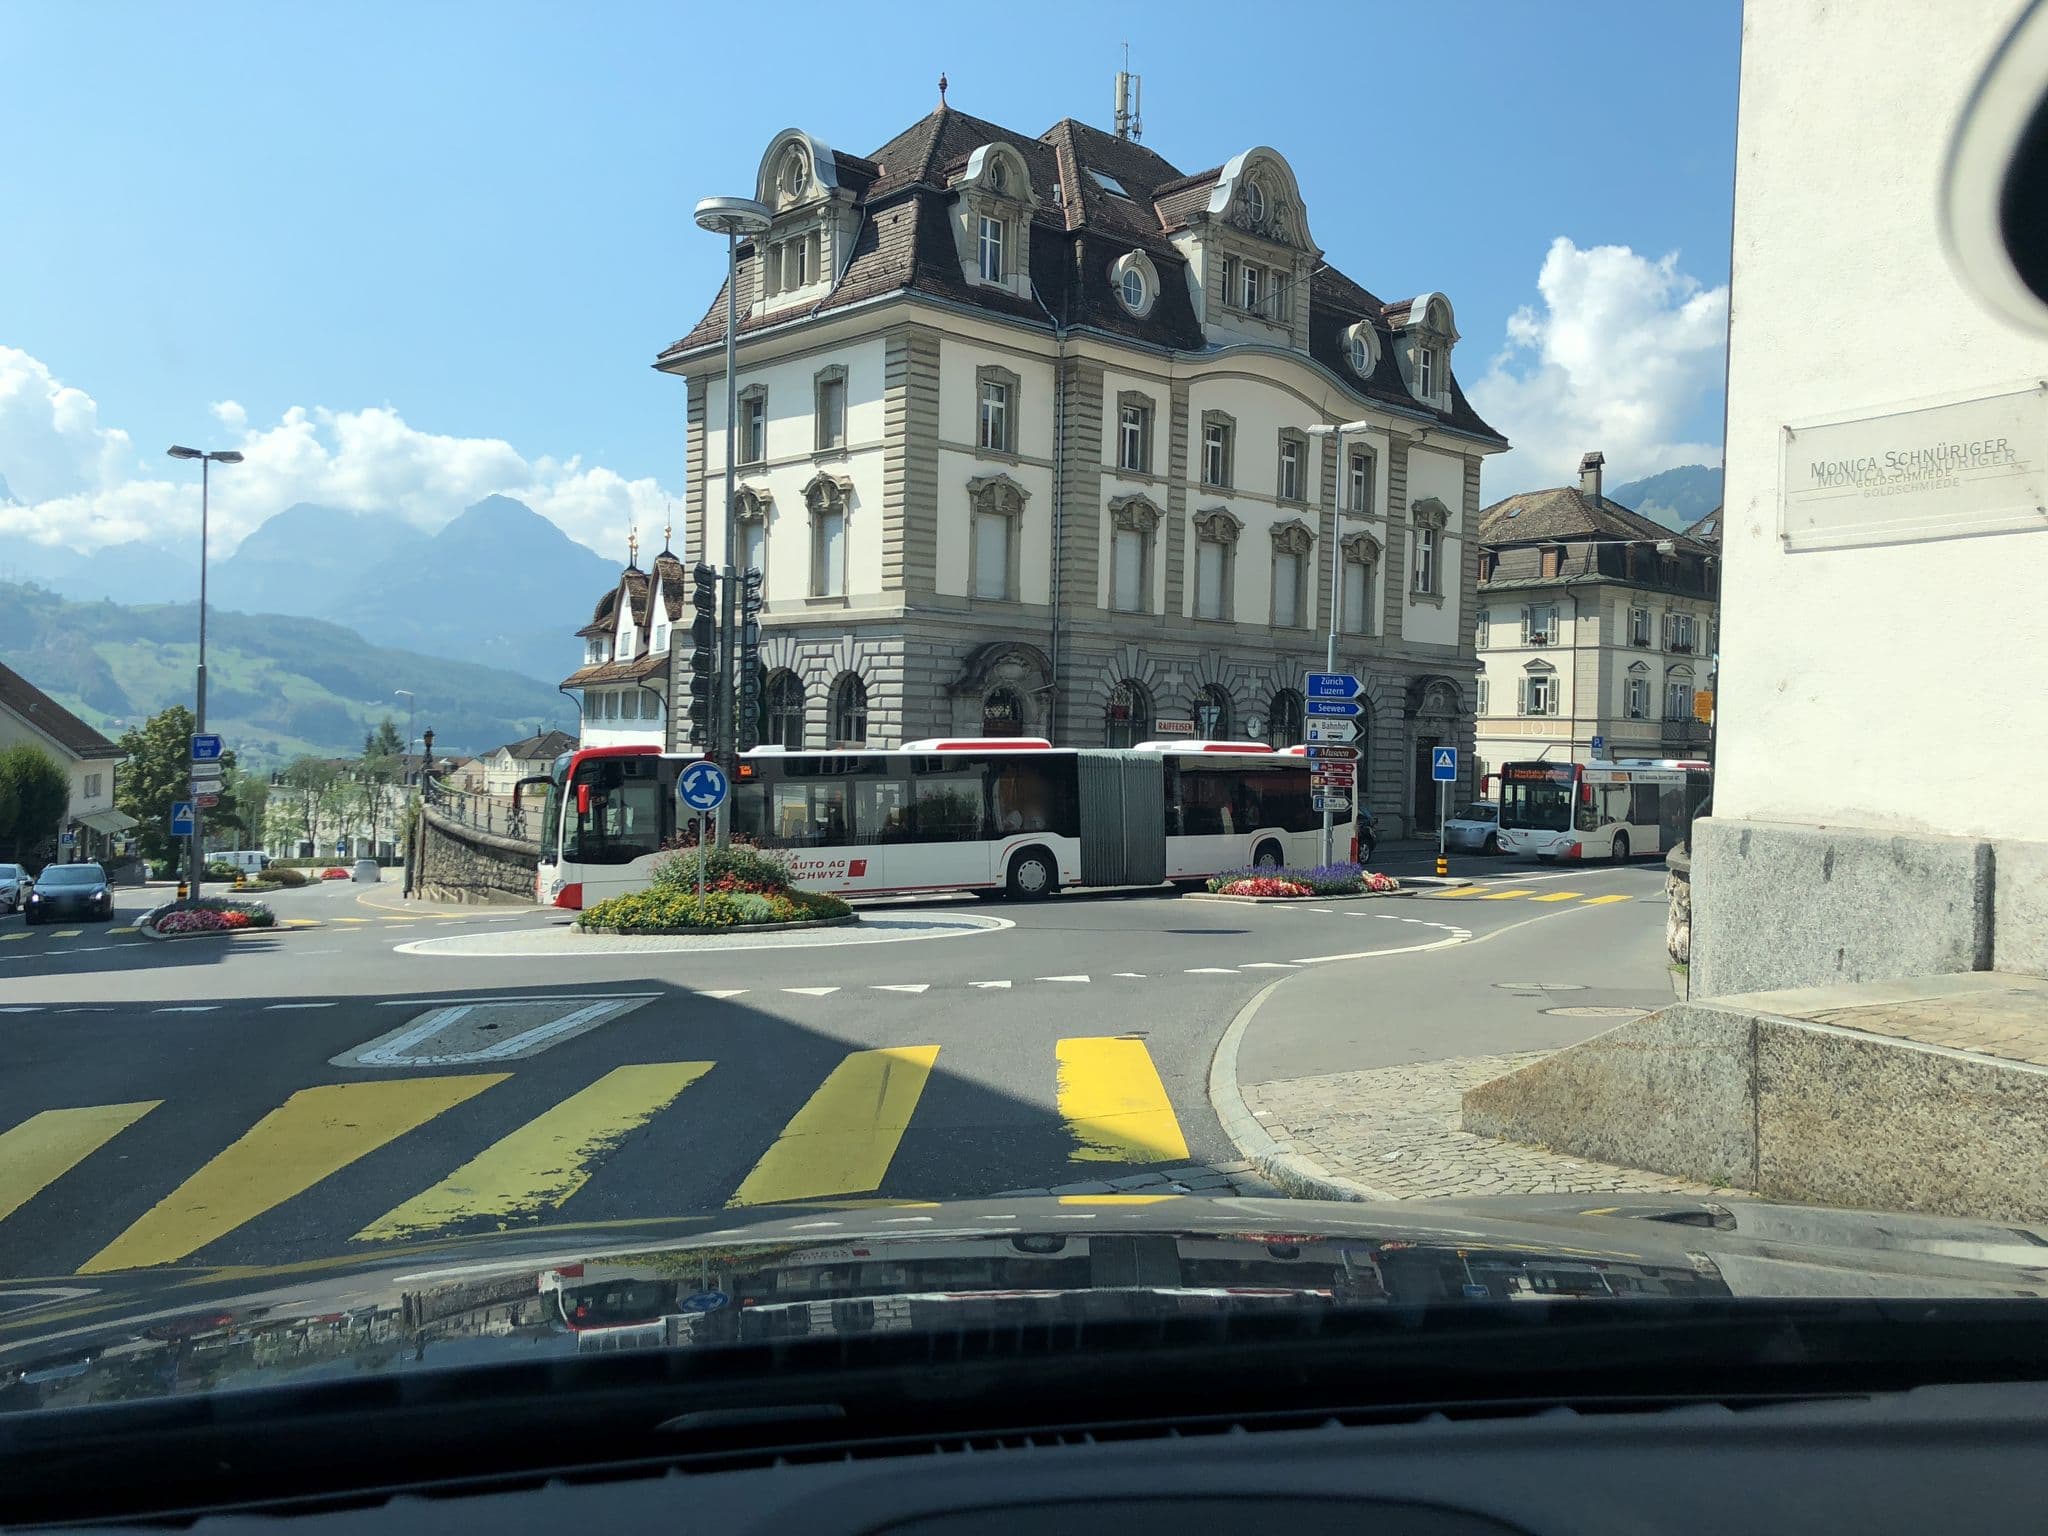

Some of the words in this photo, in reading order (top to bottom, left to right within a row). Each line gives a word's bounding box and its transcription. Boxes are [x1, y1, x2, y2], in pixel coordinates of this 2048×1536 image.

[1811, 456, 1877, 479] MONICA
[1885, 438, 2008, 468] SCHNÜRIGER
[1856, 467, 1951, 489] GOLDSCHMIEDE
[1321, 676, 1344, 686] Zürich
[1320, 686, 1345, 695] Luzern
[1318, 703, 1346, 713] Seewen
[1158, 722, 1192, 731] RAIFFEISEN
[1321, 721, 1349, 731] Bahnhof
[1320, 748, 1349, 758] Museen
[791, 861, 825, 870] AUTO
[828, 860, 846, 868] AG
[796, 870, 844, 880] CHWYZ
